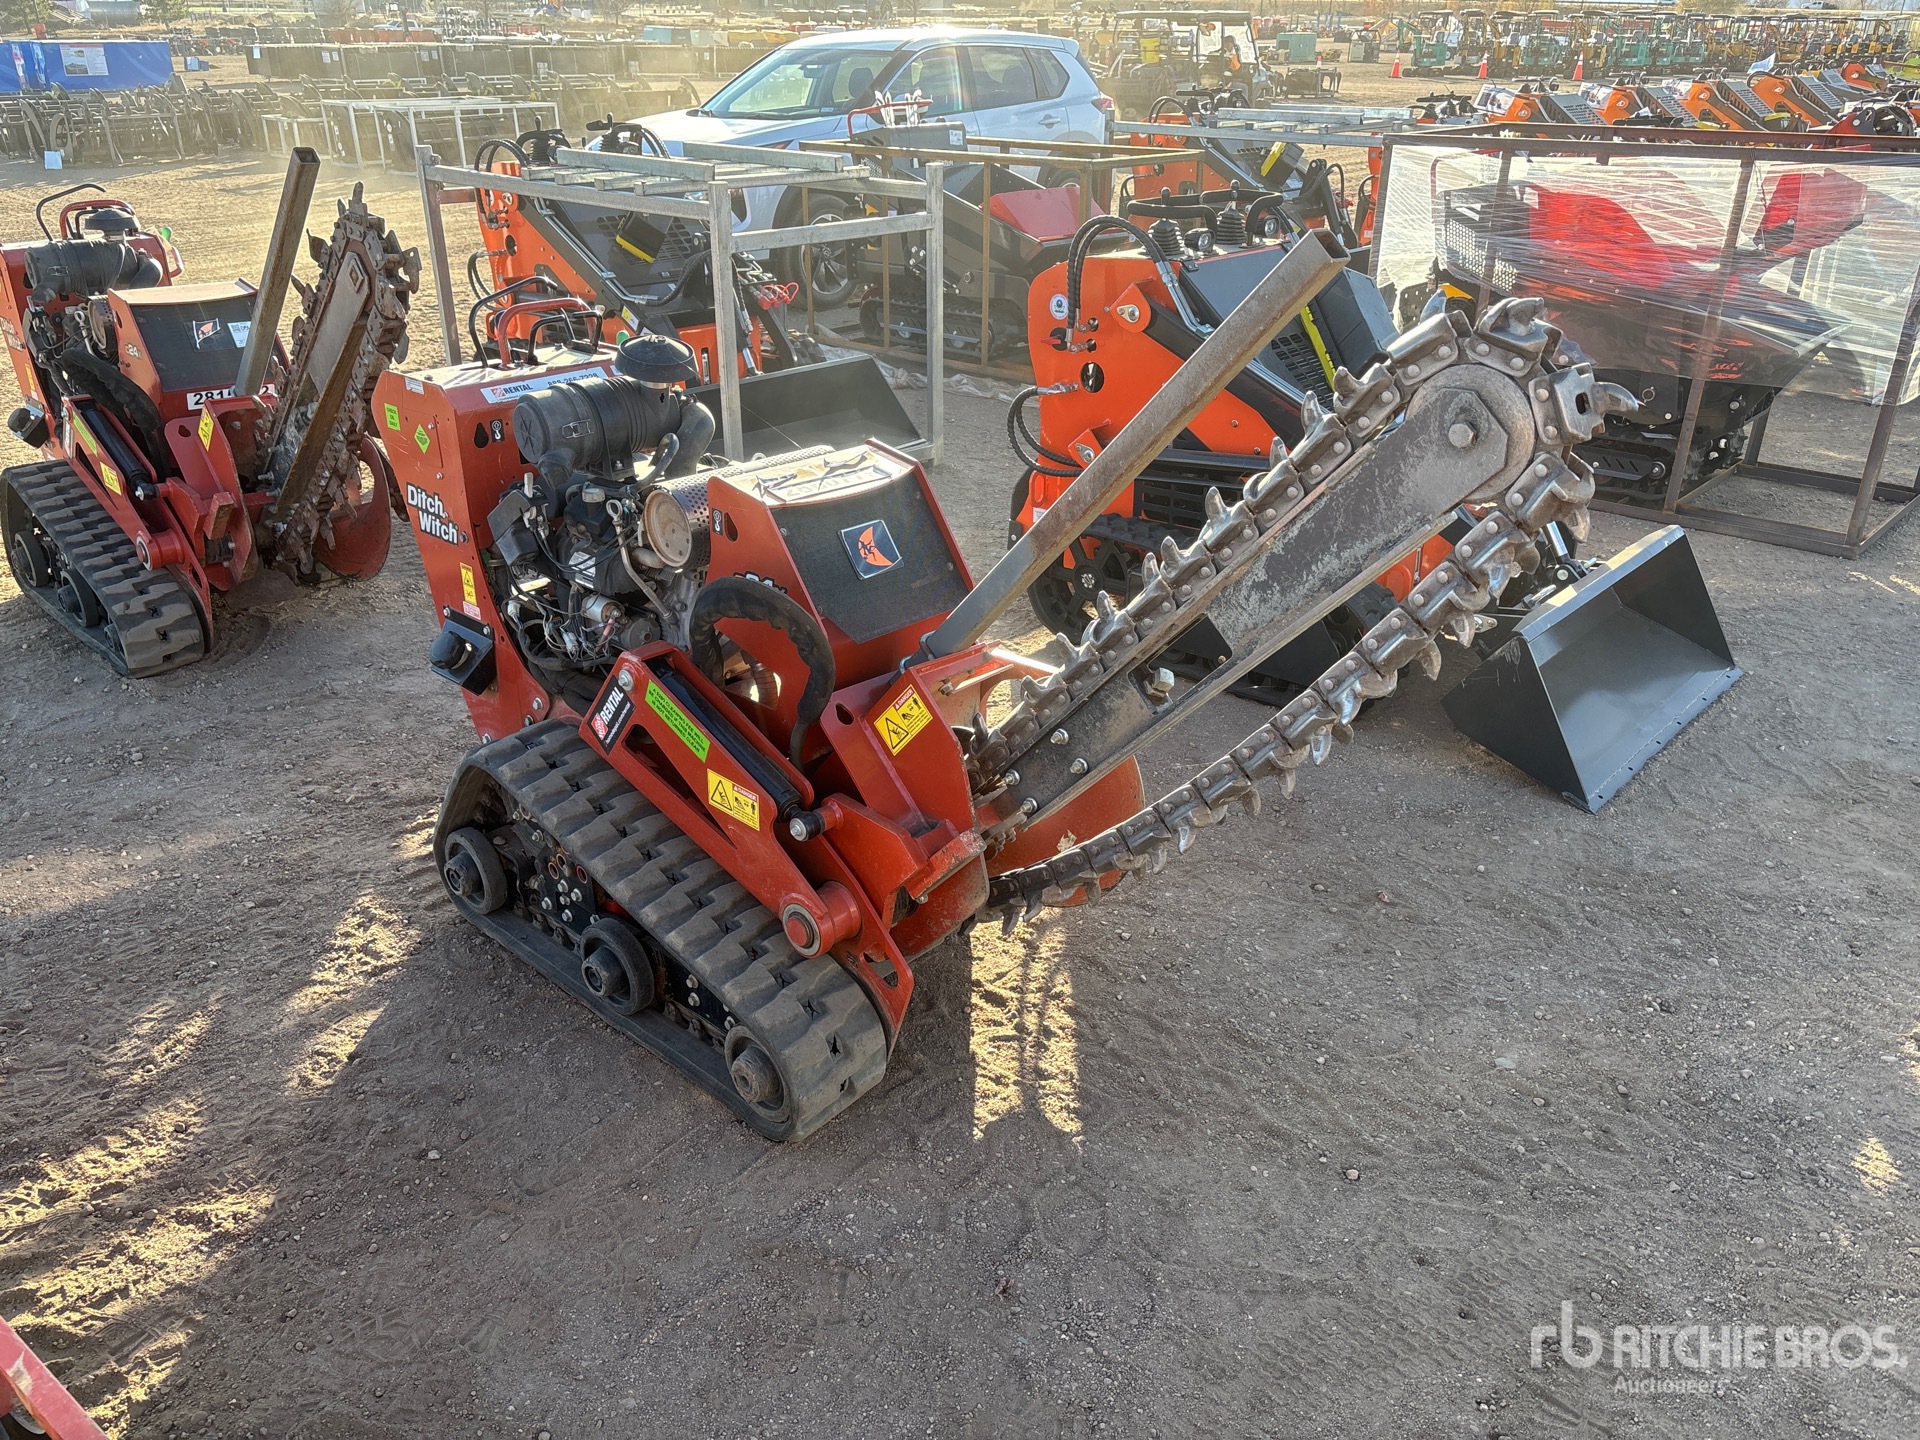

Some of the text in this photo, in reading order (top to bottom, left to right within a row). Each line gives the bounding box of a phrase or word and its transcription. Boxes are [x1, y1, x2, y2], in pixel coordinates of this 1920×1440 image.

[503, 384, 533, 394] RENTAL
[407, 484, 444, 518] Ditch
[419, 510, 458, 544] Witch
[600, 686, 624, 724] RENTAL
[665, 700, 685, 724] CLEANING
[898, 688, 913, 706] DANGER
[654, 695, 673, 718] CHARGED
[687, 730, 706, 752] MACHINE
[664, 712, 685, 738] RETURNED
[685, 735, 699, 752] CLEAN
